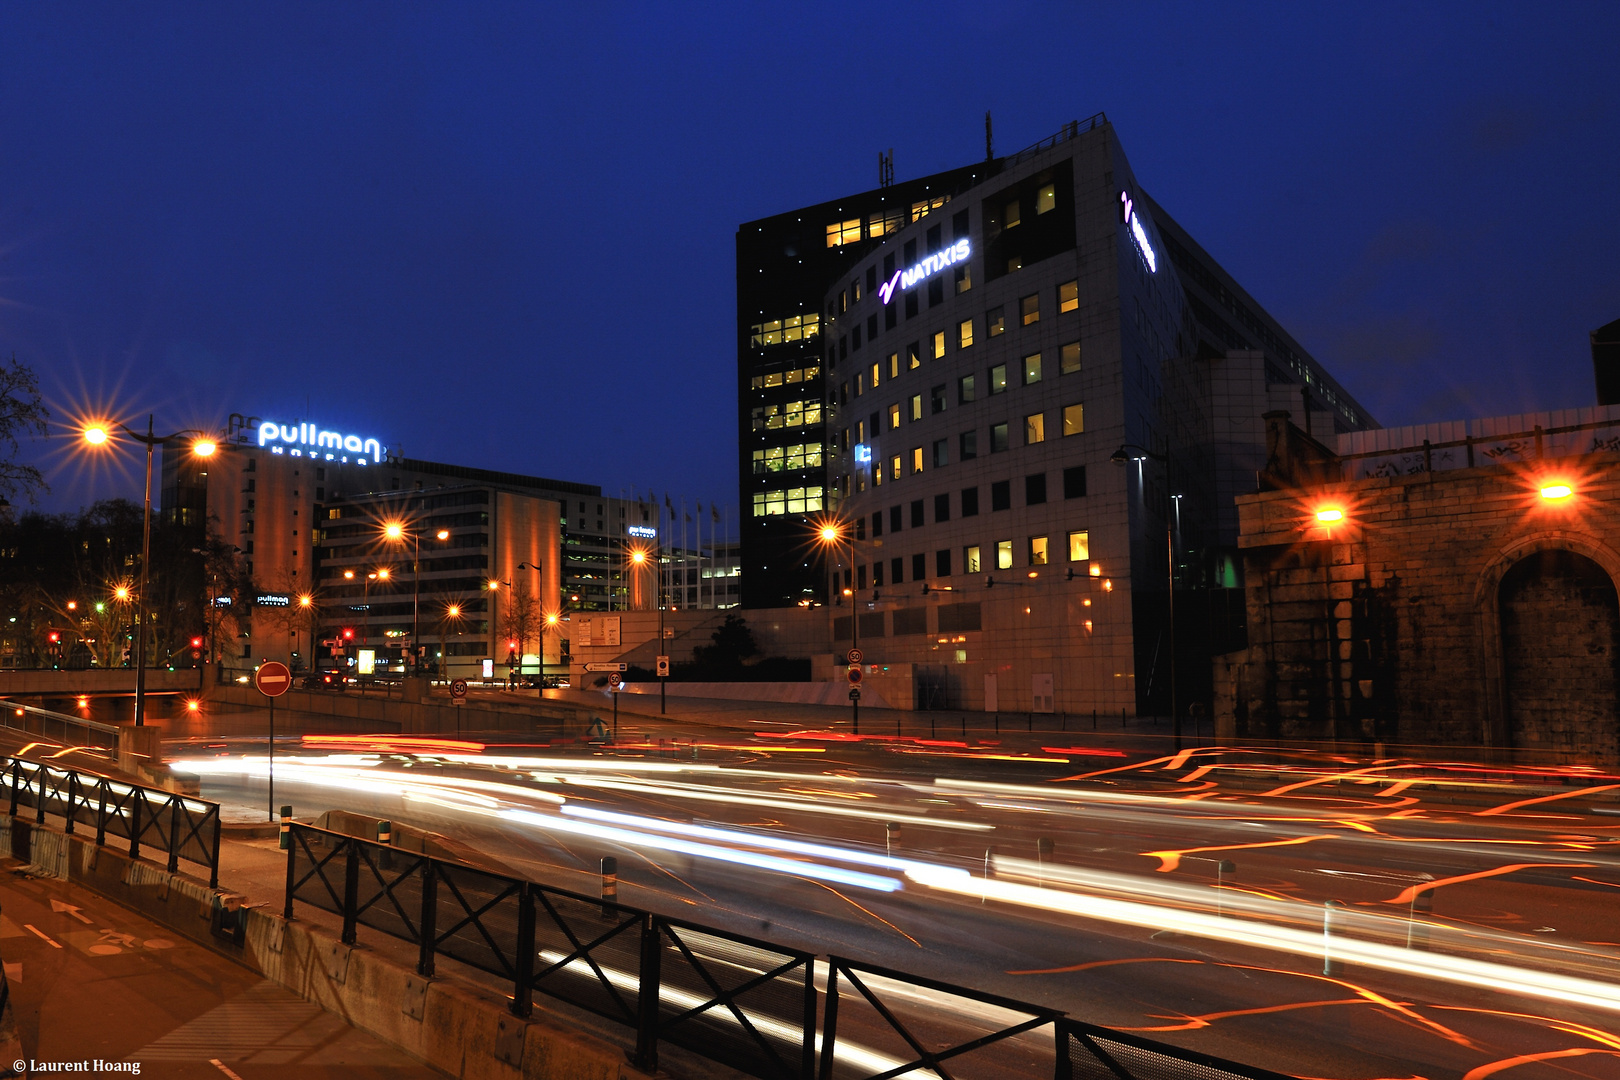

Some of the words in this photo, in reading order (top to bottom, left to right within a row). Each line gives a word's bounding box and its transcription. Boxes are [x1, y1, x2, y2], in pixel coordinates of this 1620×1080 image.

[900, 238, 971, 290] NATIXIS
[258, 421, 381, 463] pullman
[257, 595, 289, 604] pullman
[455, 684, 465, 693] 50
